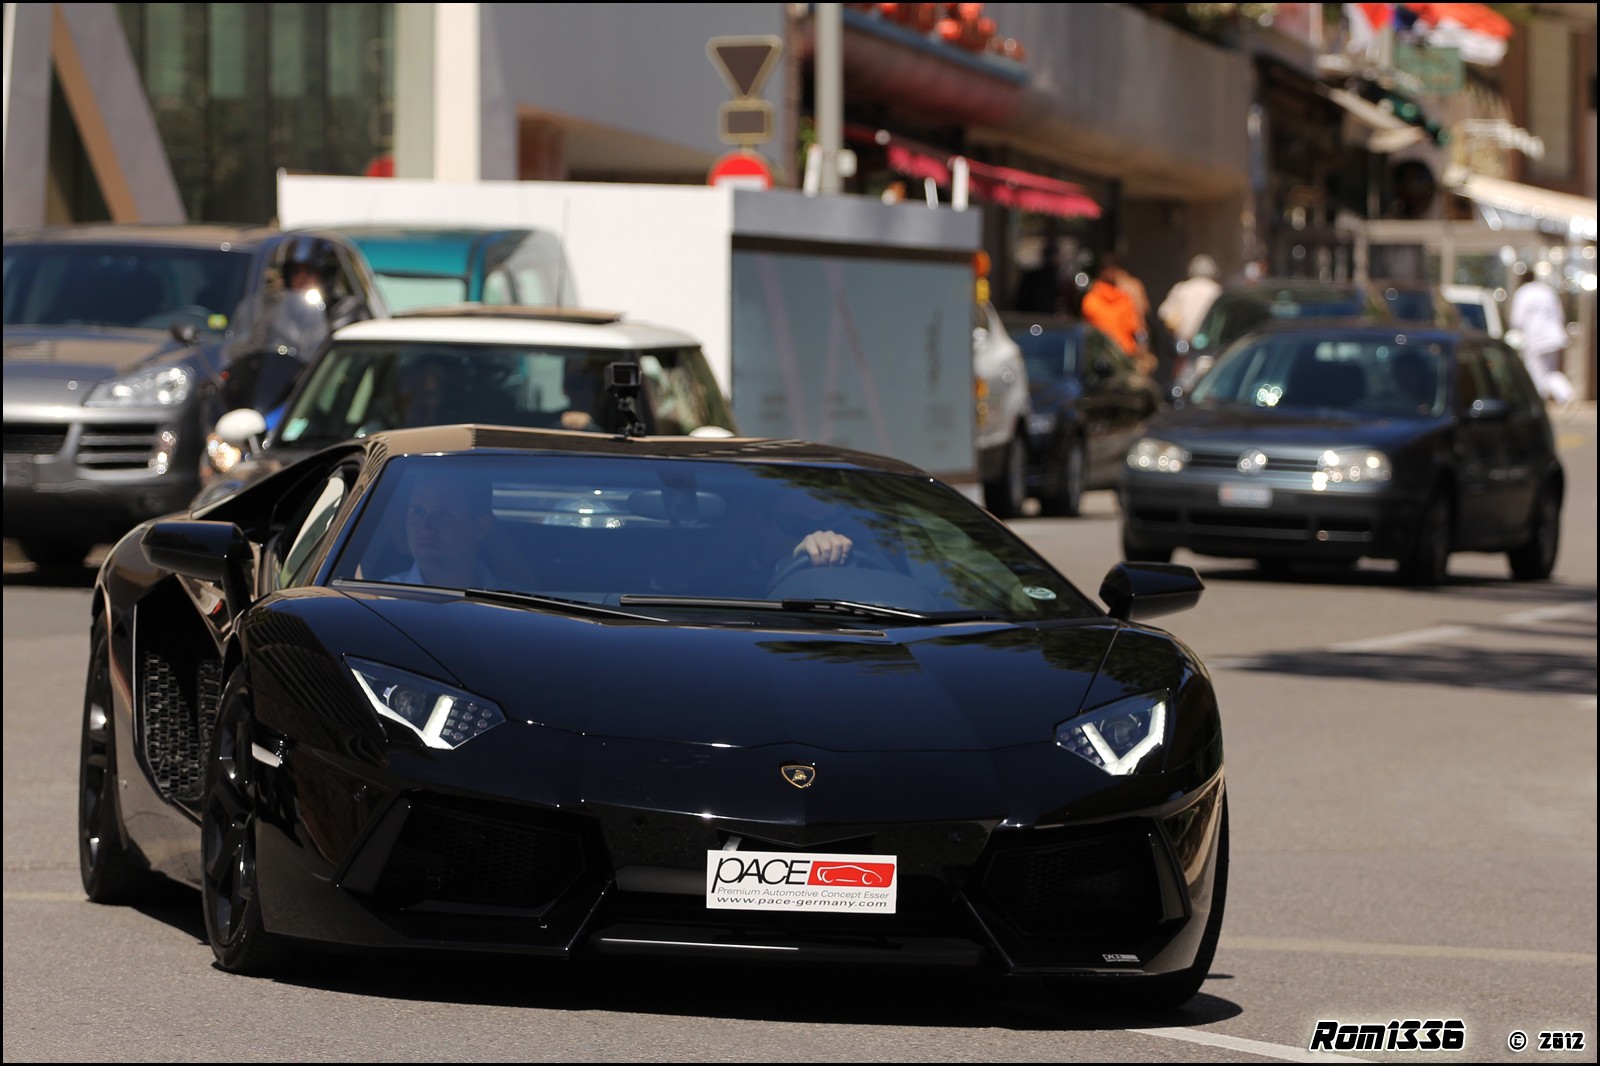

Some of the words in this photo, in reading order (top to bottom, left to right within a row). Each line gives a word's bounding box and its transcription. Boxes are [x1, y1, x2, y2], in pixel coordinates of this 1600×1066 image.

[717, 887, 761, 896] Premium
[763, 888, 818, 897] Automotive
[821, 890, 861, 899] Concept
[863, 891, 889, 899] Esser
[717, 897, 887, 907] www.pace-germany.com
